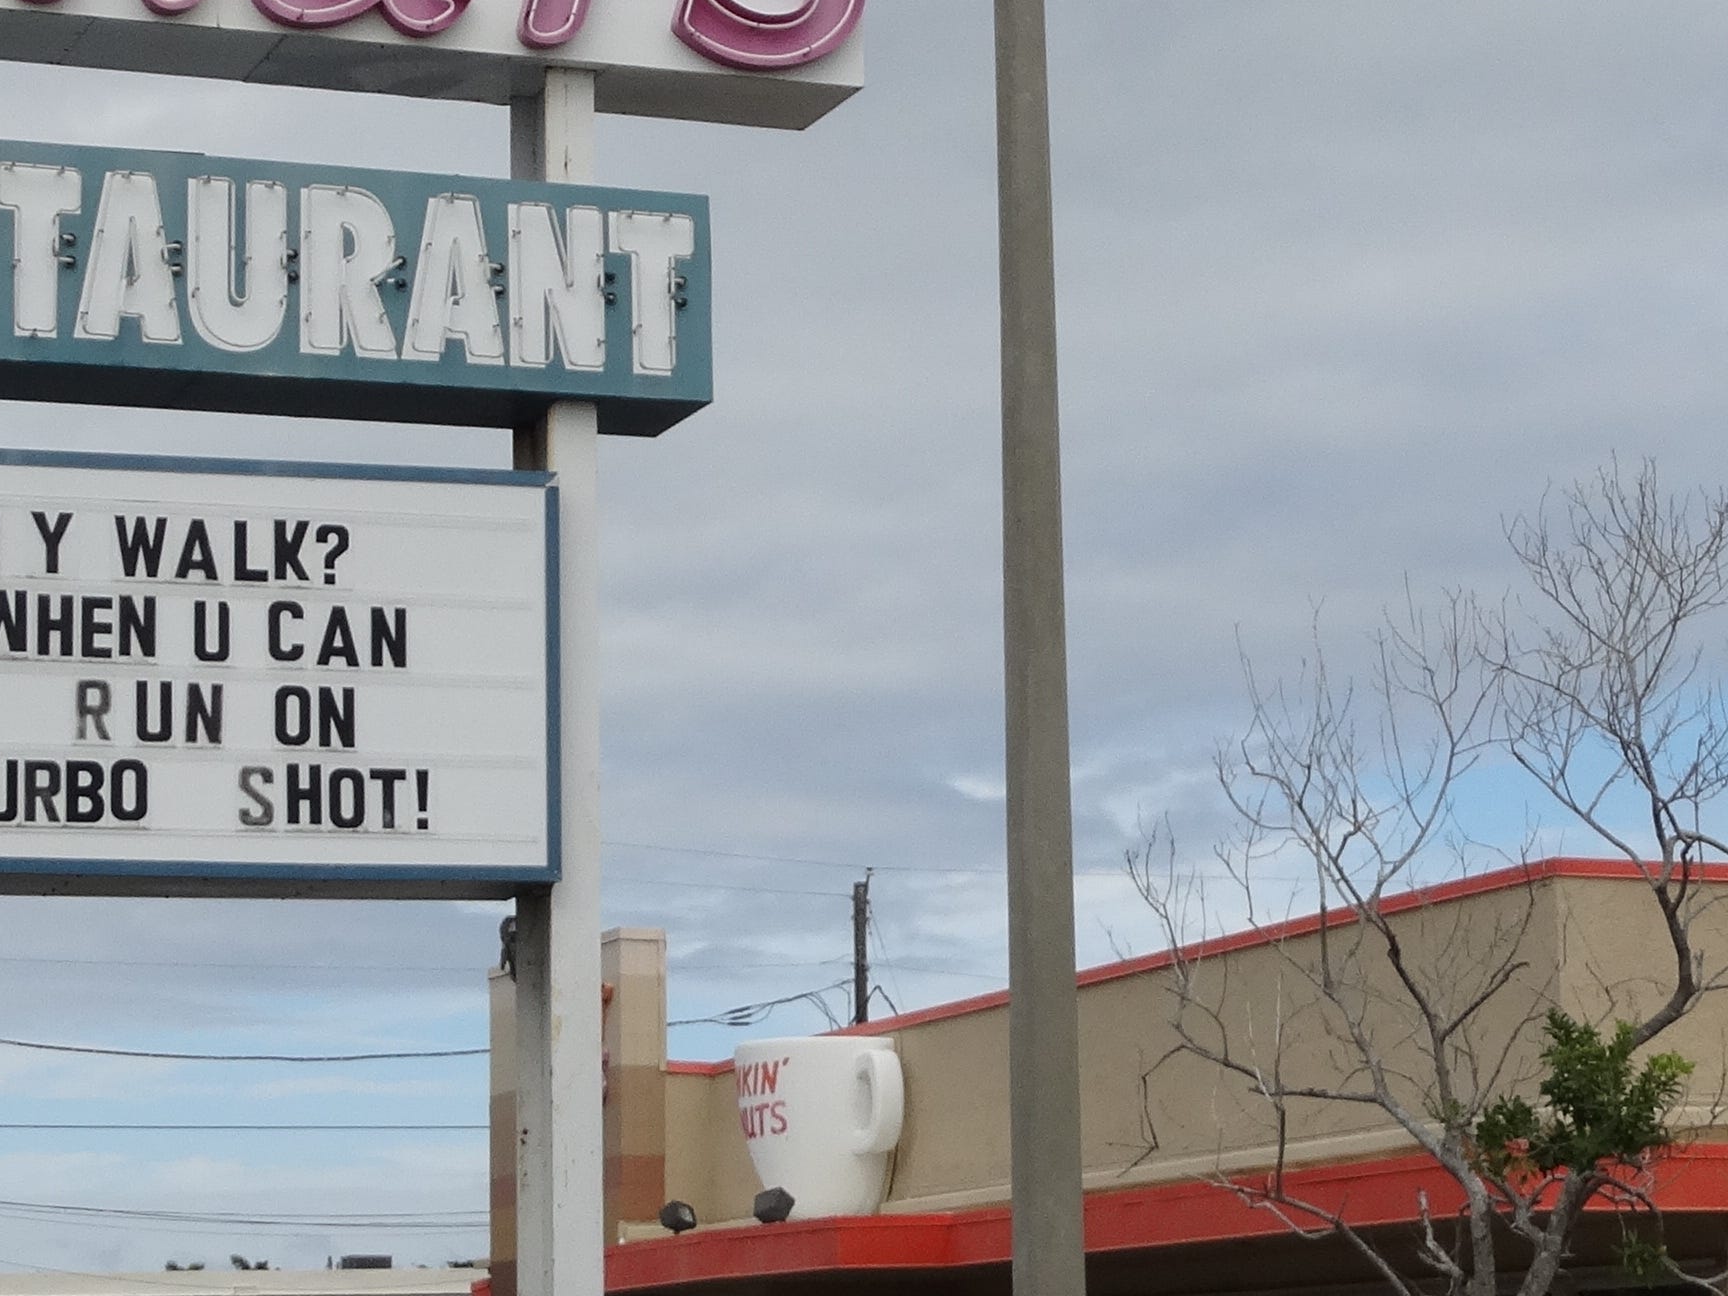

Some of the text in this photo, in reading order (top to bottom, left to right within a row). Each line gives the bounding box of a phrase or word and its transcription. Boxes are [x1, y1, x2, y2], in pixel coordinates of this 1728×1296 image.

[114, 515, 351, 586] WALK?
[193, 600, 231, 664] U
[267, 600, 408, 670] CAN
[77, 679, 356, 749] RUN ON
[239, 763, 430, 831] SHOT!
